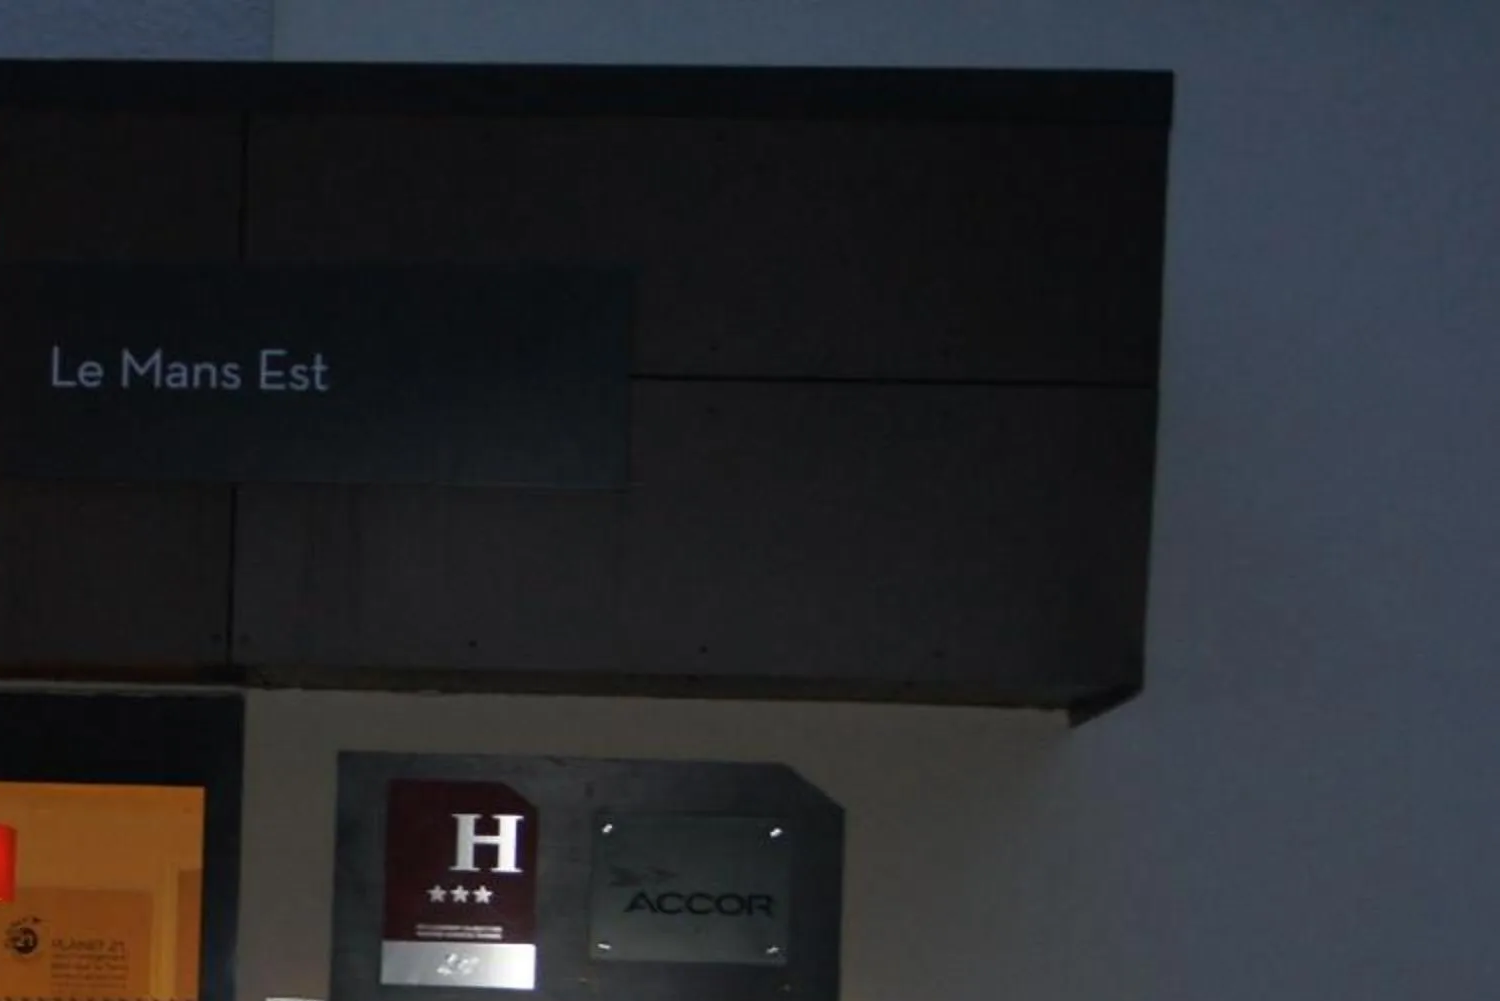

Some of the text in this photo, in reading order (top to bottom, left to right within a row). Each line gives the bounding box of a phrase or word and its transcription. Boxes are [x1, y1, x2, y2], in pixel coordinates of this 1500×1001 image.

[51, 347, 329, 392] Le Mans Est
[450, 813, 524, 874] H
[624, 890, 775, 917] ACCOR
